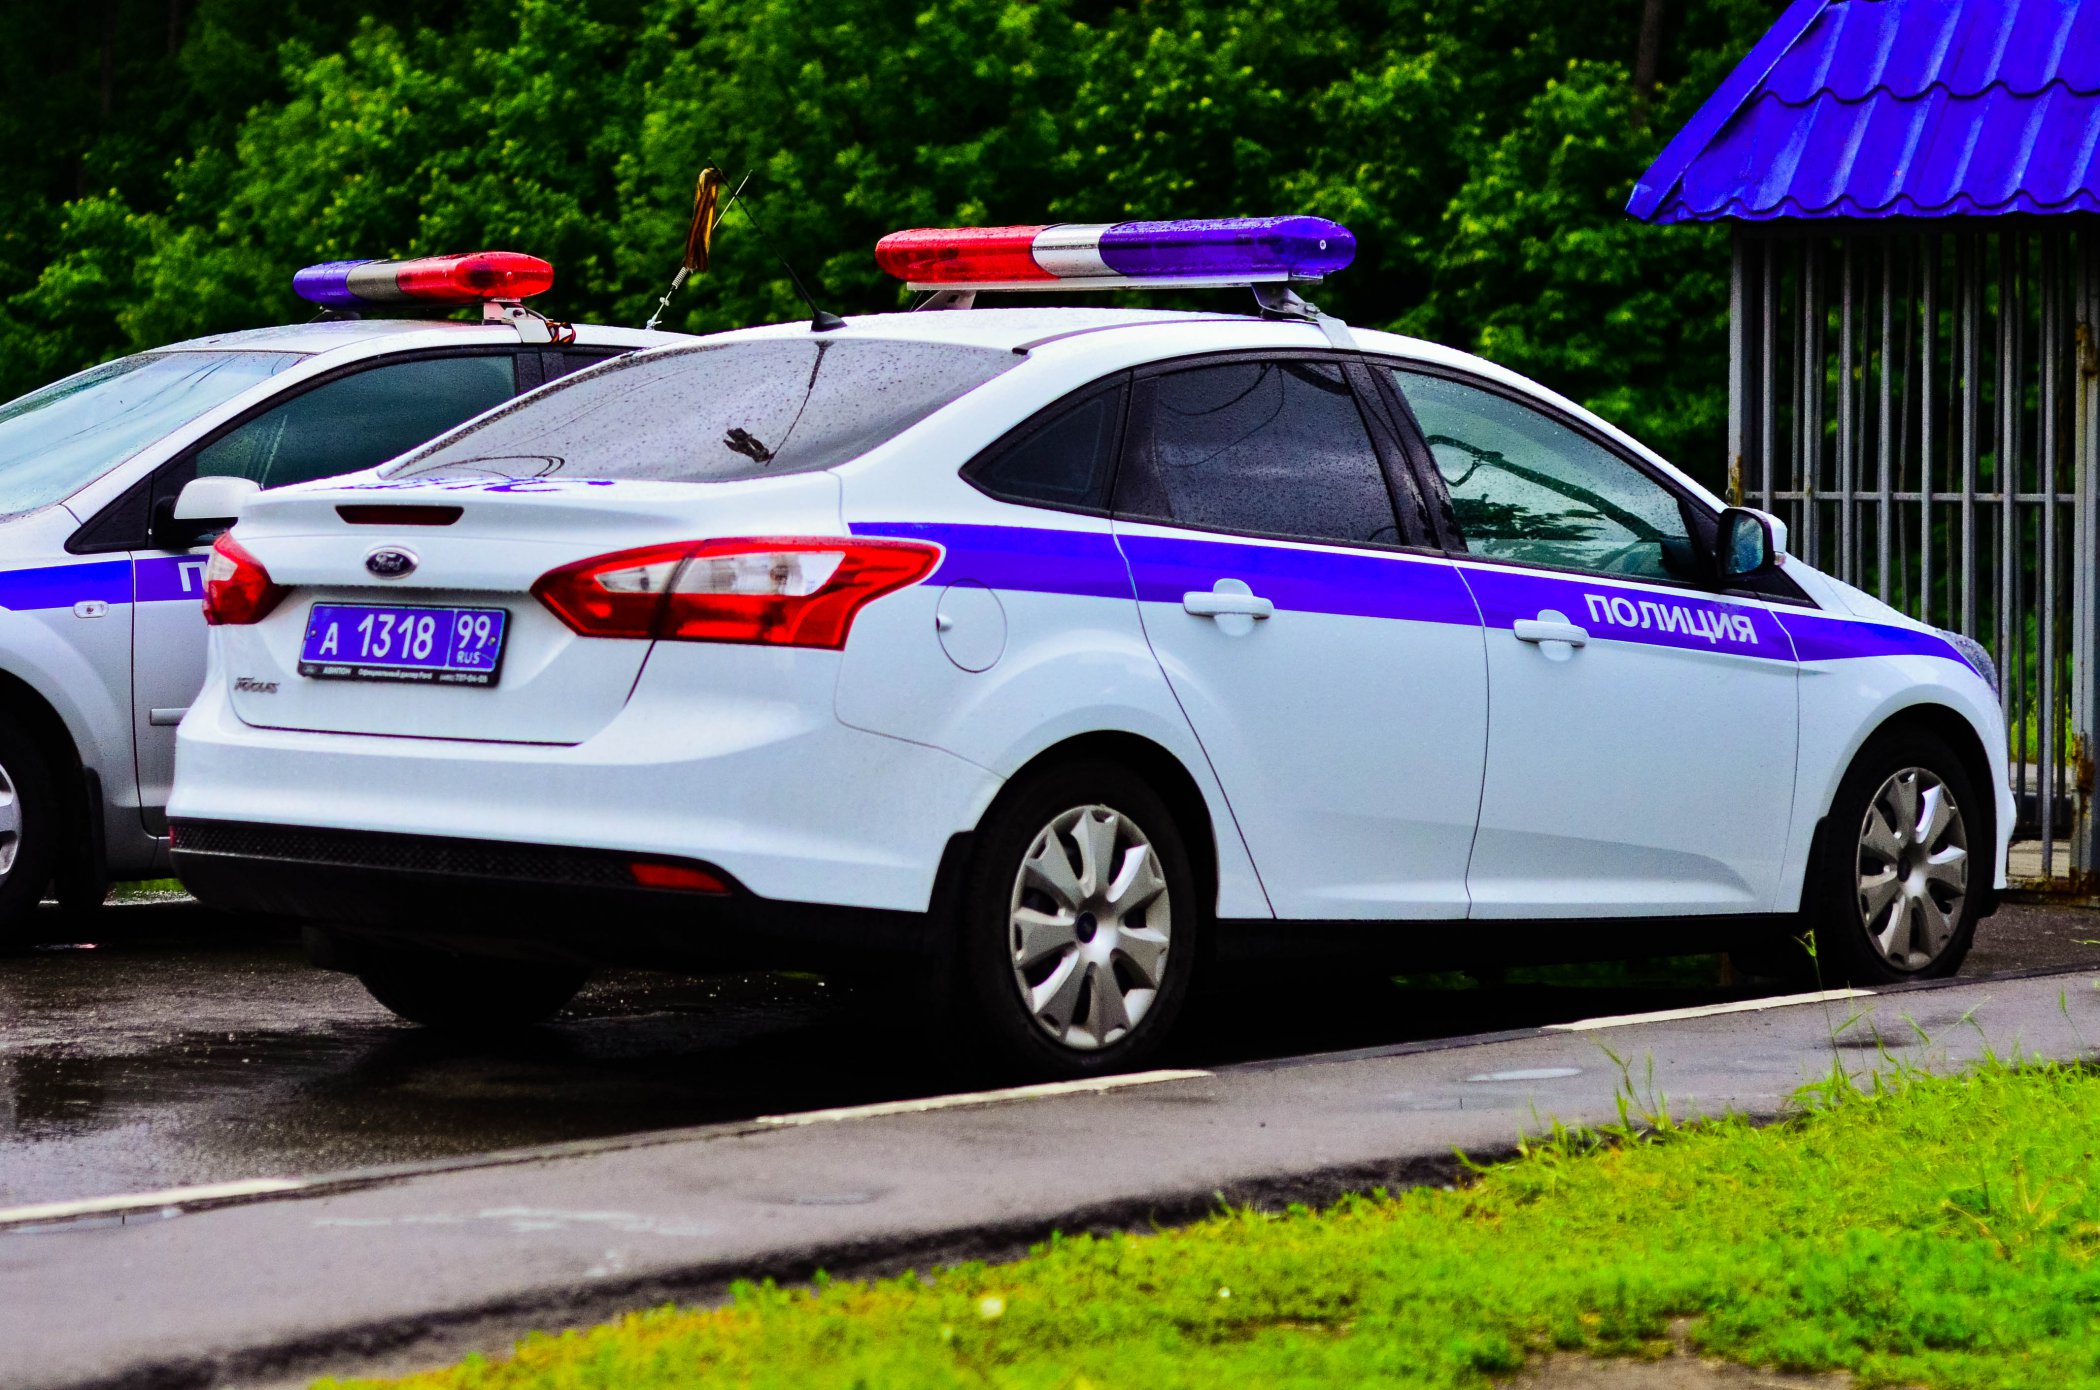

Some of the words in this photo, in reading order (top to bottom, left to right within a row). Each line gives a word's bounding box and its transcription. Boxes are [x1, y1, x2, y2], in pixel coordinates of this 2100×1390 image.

[371, 552, 405, 571] Ford
[1584, 593, 1759, 645] ПОЛИЦИЯ
[357, 614, 436, 660] 1318
[457, 615, 491, 650] 99
[456, 651, 480, 664] RUS
